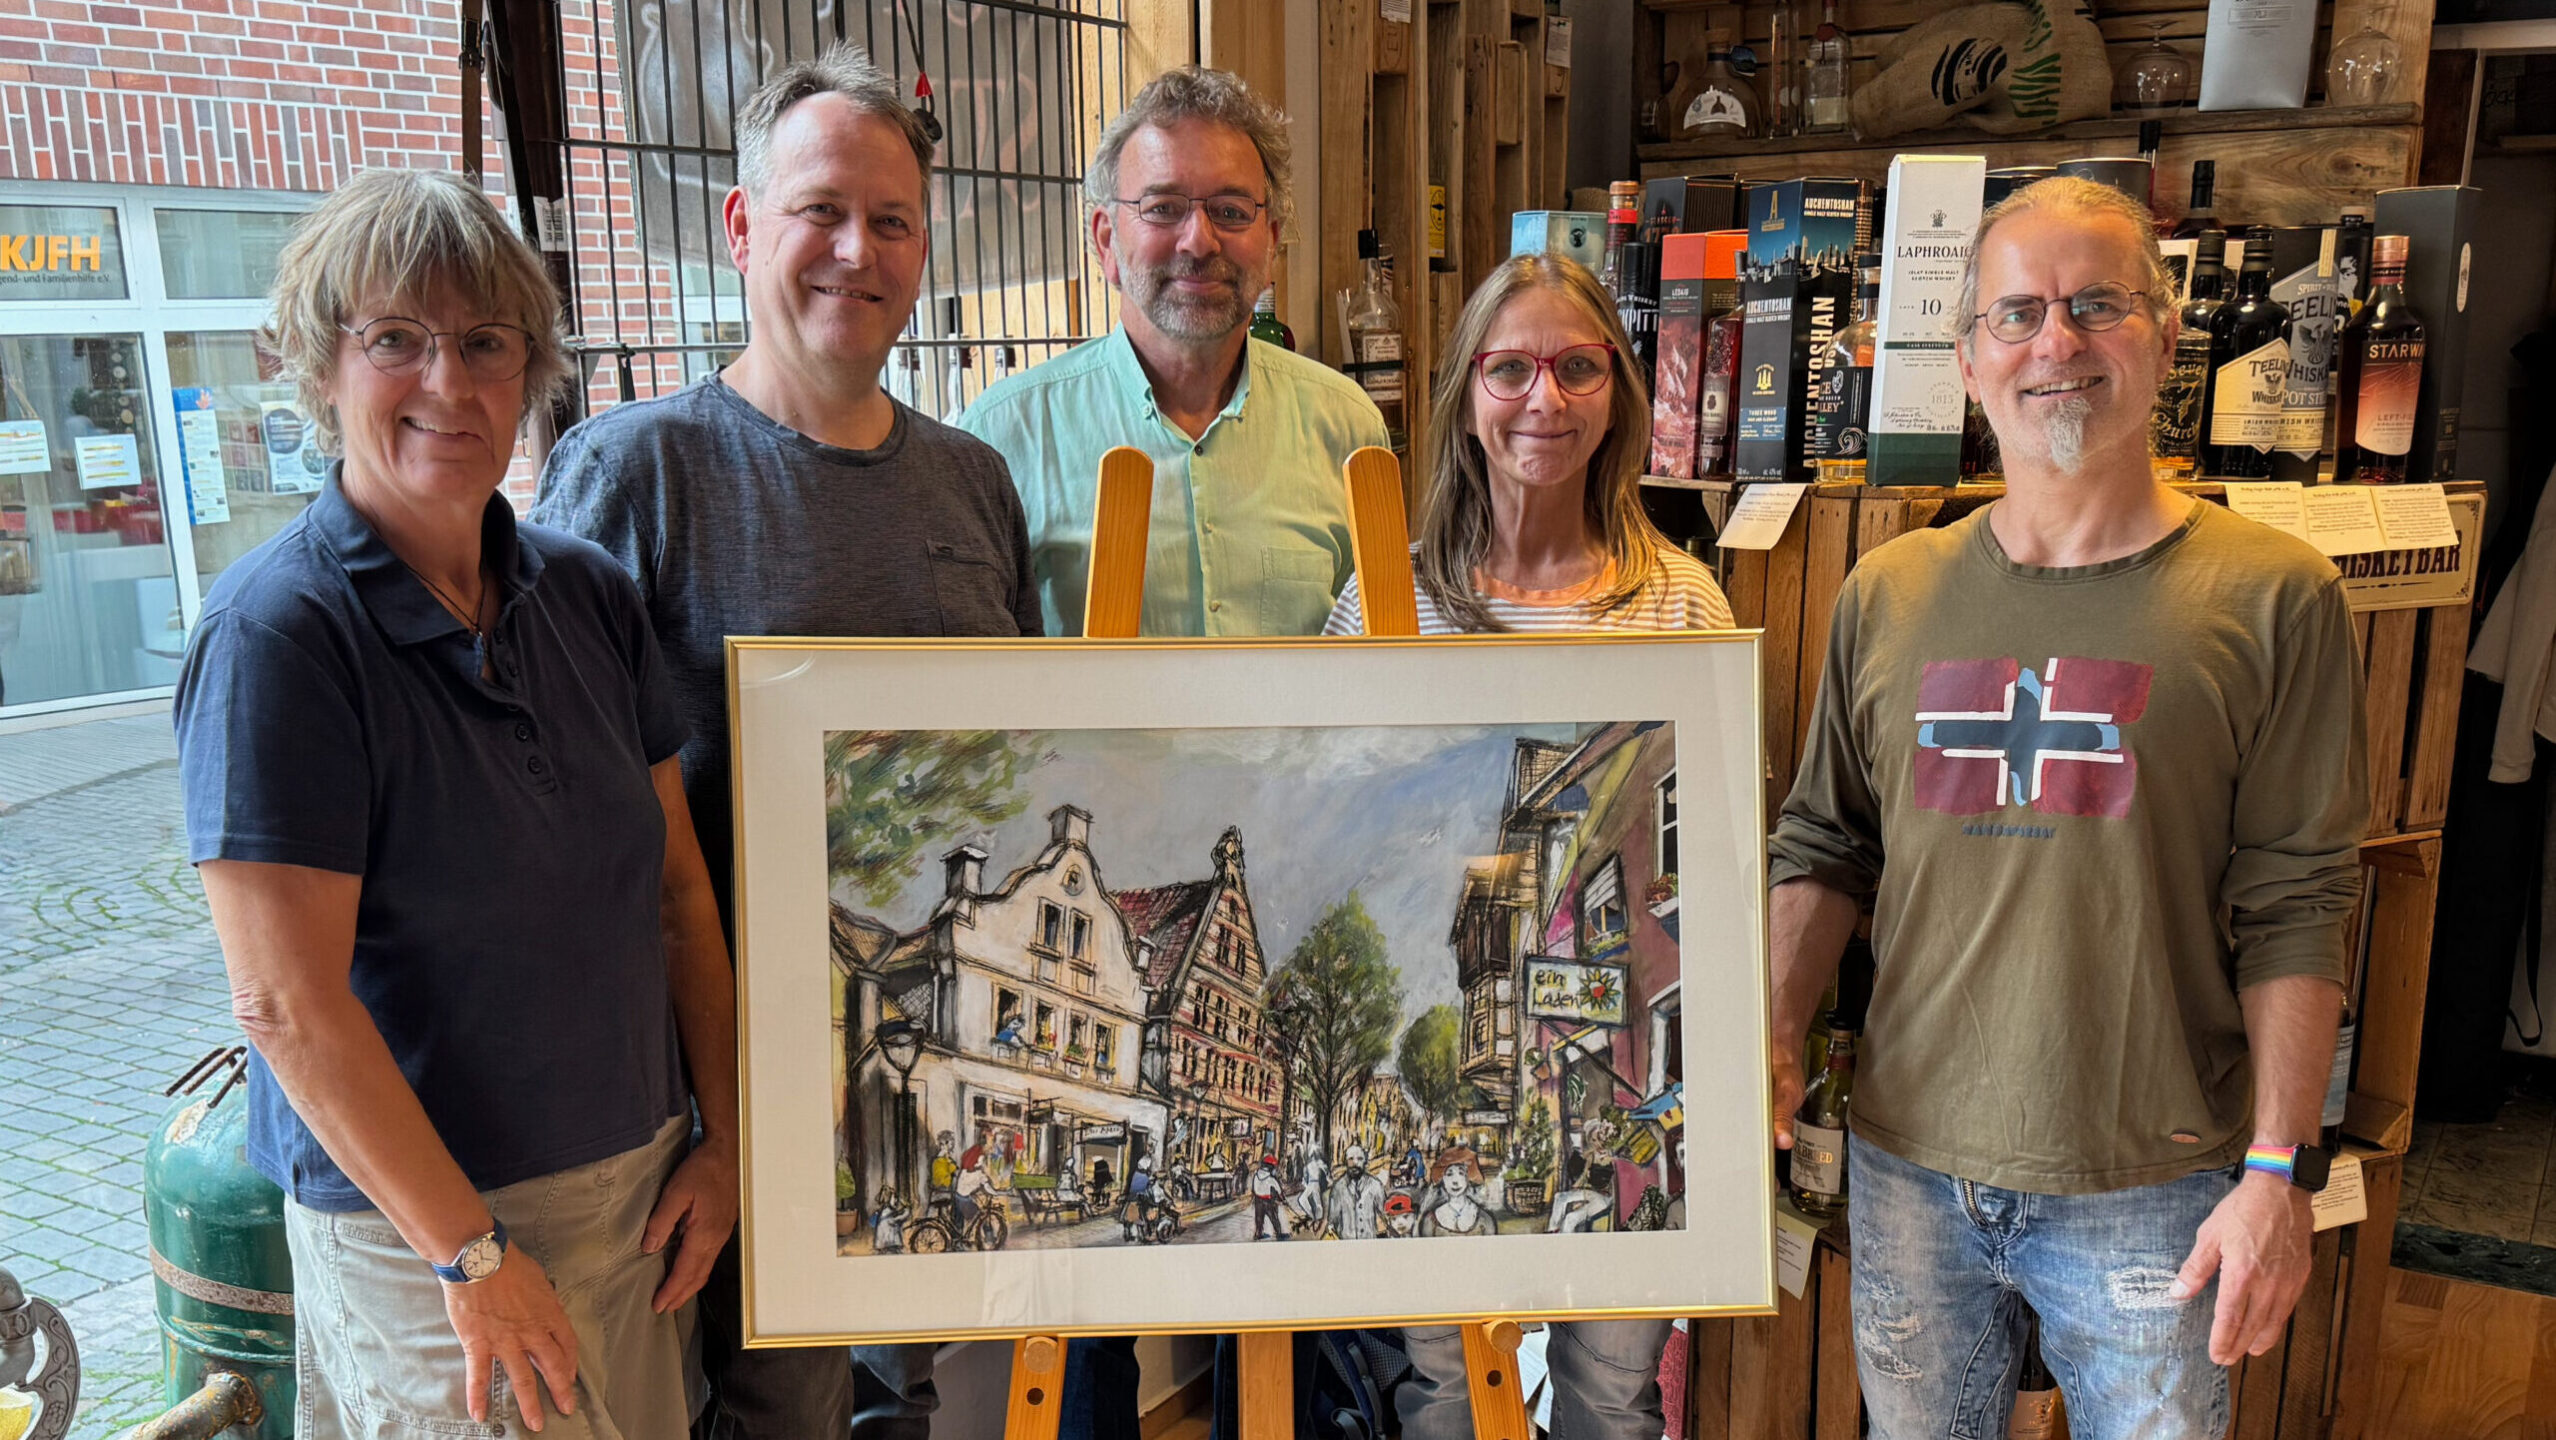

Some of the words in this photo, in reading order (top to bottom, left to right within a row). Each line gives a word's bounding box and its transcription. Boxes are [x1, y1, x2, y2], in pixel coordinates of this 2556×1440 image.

[1804, 198, 1855, 211] AUCHENTOSHAN
[0, 234, 101, 272] KJFH
[1746, 297, 1792, 314] AUCHENTOSHAN
[1921, 299, 1942, 315] 10
[2280, 295, 2336, 322] EELI
[2282, 389, 2307, 405] POT
[1534, 968, 1568, 986] ein
[1533, 987, 1580, 1010] Laden
